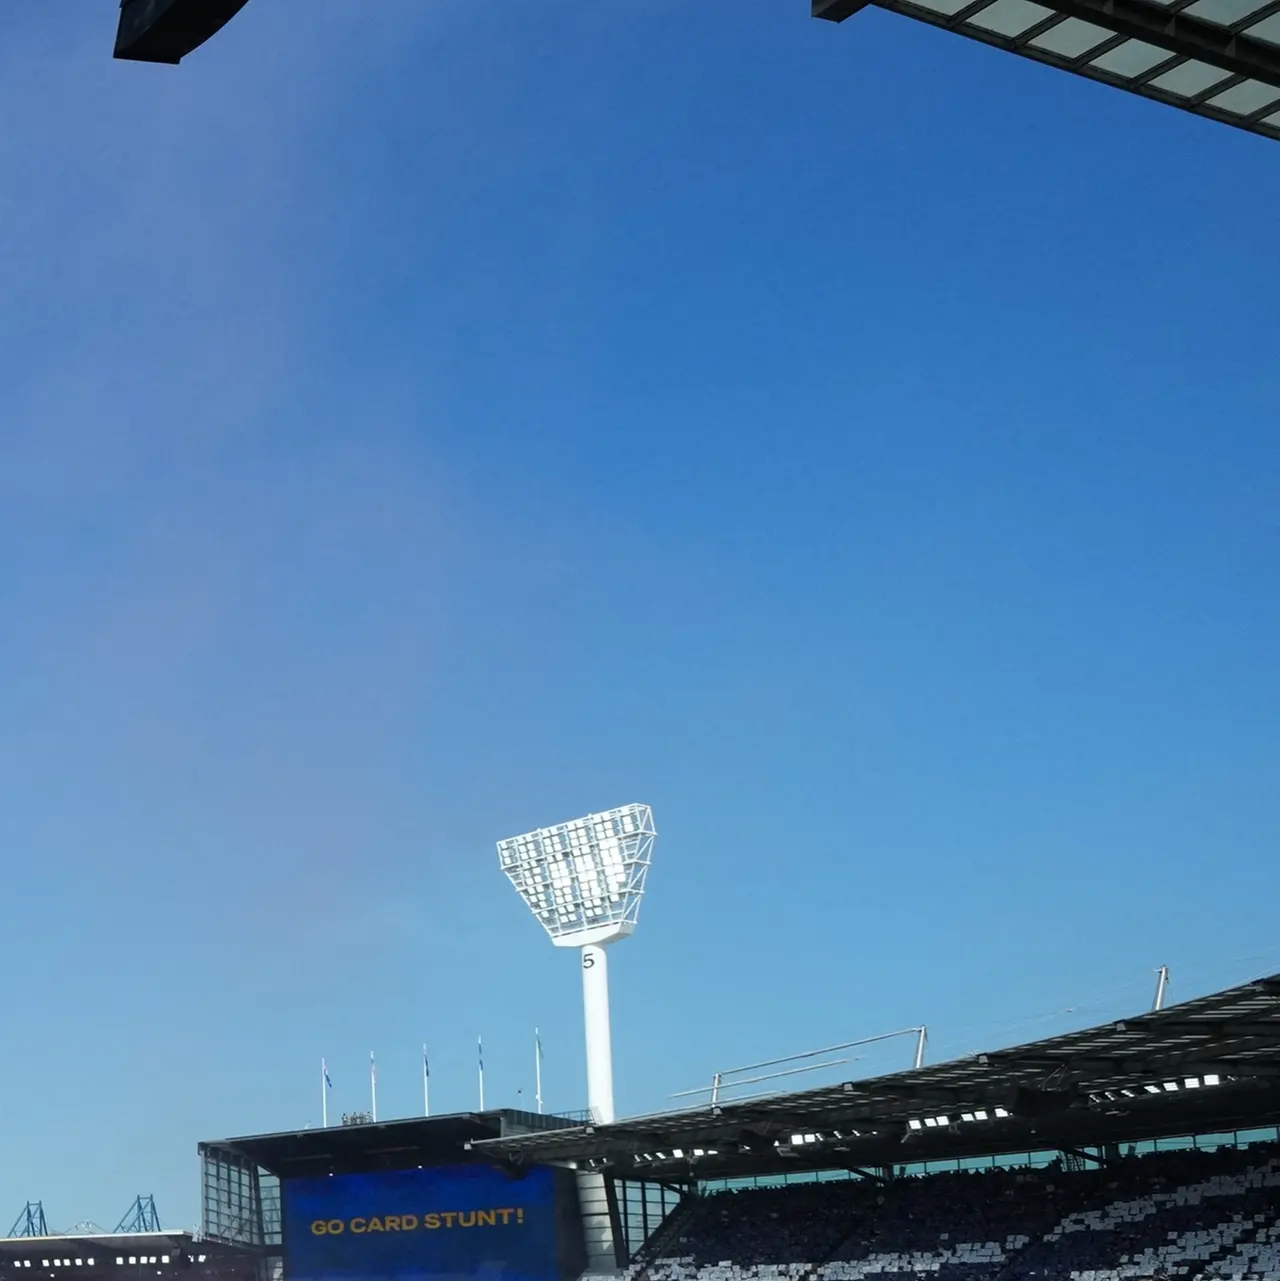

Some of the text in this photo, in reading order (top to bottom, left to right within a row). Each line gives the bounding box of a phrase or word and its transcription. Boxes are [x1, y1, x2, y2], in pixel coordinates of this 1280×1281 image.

[311, 1208, 523, 1235] GO CARD STUNT!
